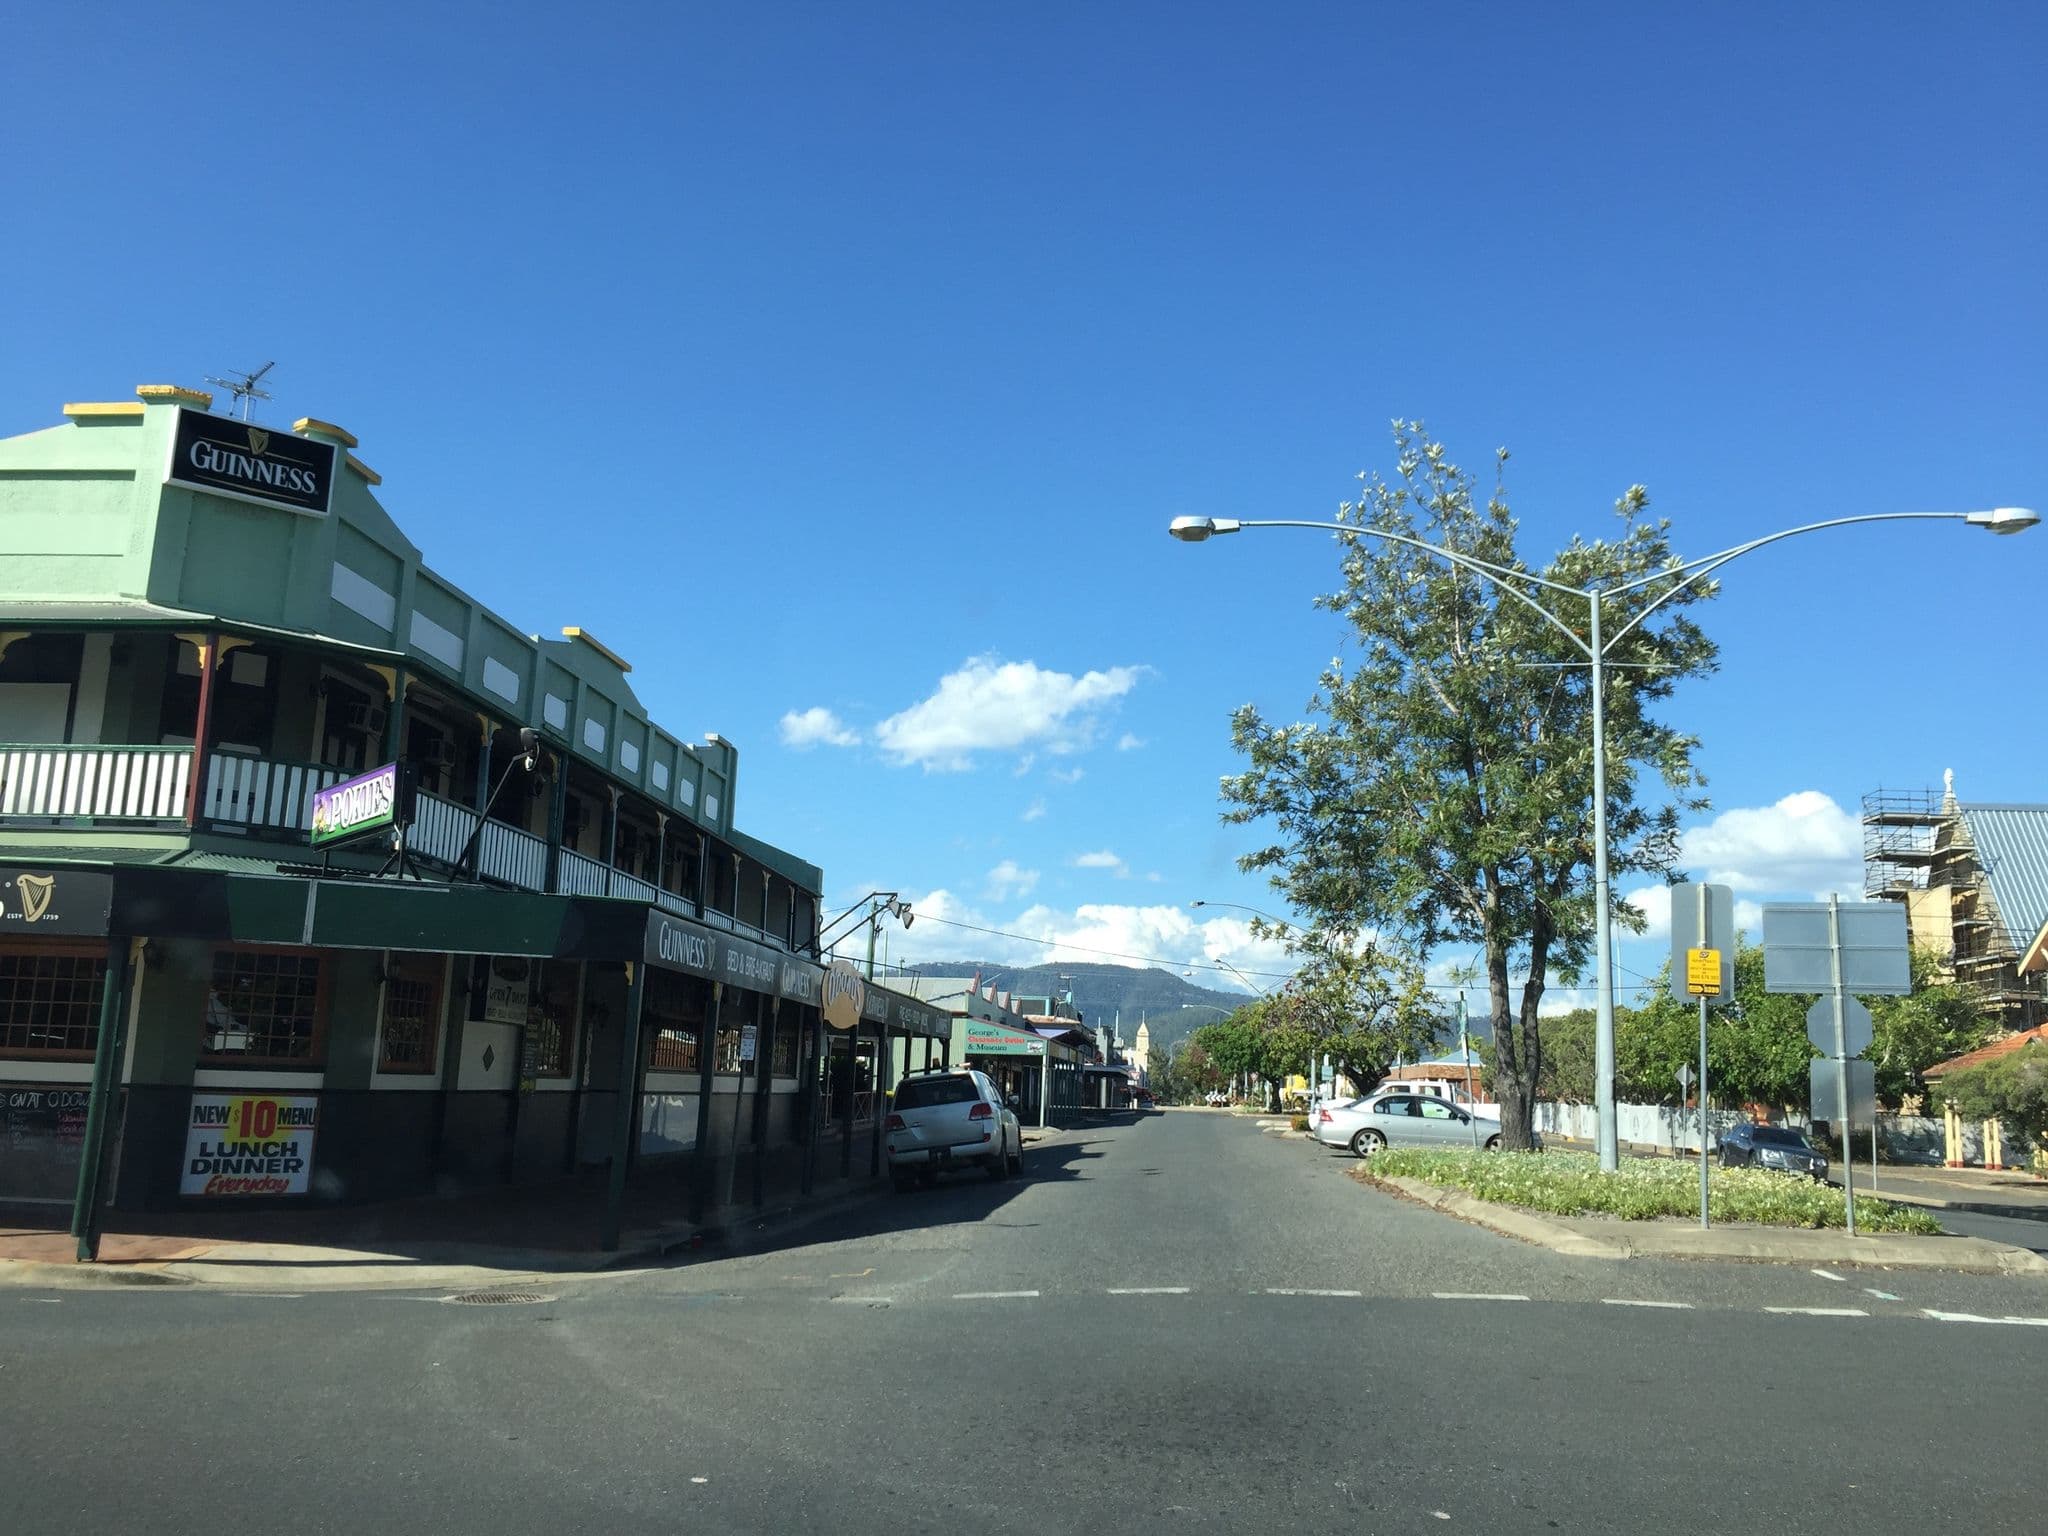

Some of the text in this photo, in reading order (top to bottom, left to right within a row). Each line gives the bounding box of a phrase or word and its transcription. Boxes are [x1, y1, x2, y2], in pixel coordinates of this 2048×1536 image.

[190, 440, 317, 494] GUINNESS
[328, 771, 393, 833] POKIES
[659, 920, 706, 969] GUINNESS
[727, 949, 739, 971] BED
[745, 955, 776, 983] BREAKFAST
[505, 985, 513, 1007] 7
[968, 1028, 999, 1036] George's
[192, 1105, 231, 1123] NEW
[277, 1107, 317, 1125] MENU
[198, 1141, 298, 1157] LUNCH
[190, 1158, 304, 1174] DINNER
[203, 1174, 290, 1195] Everyday
